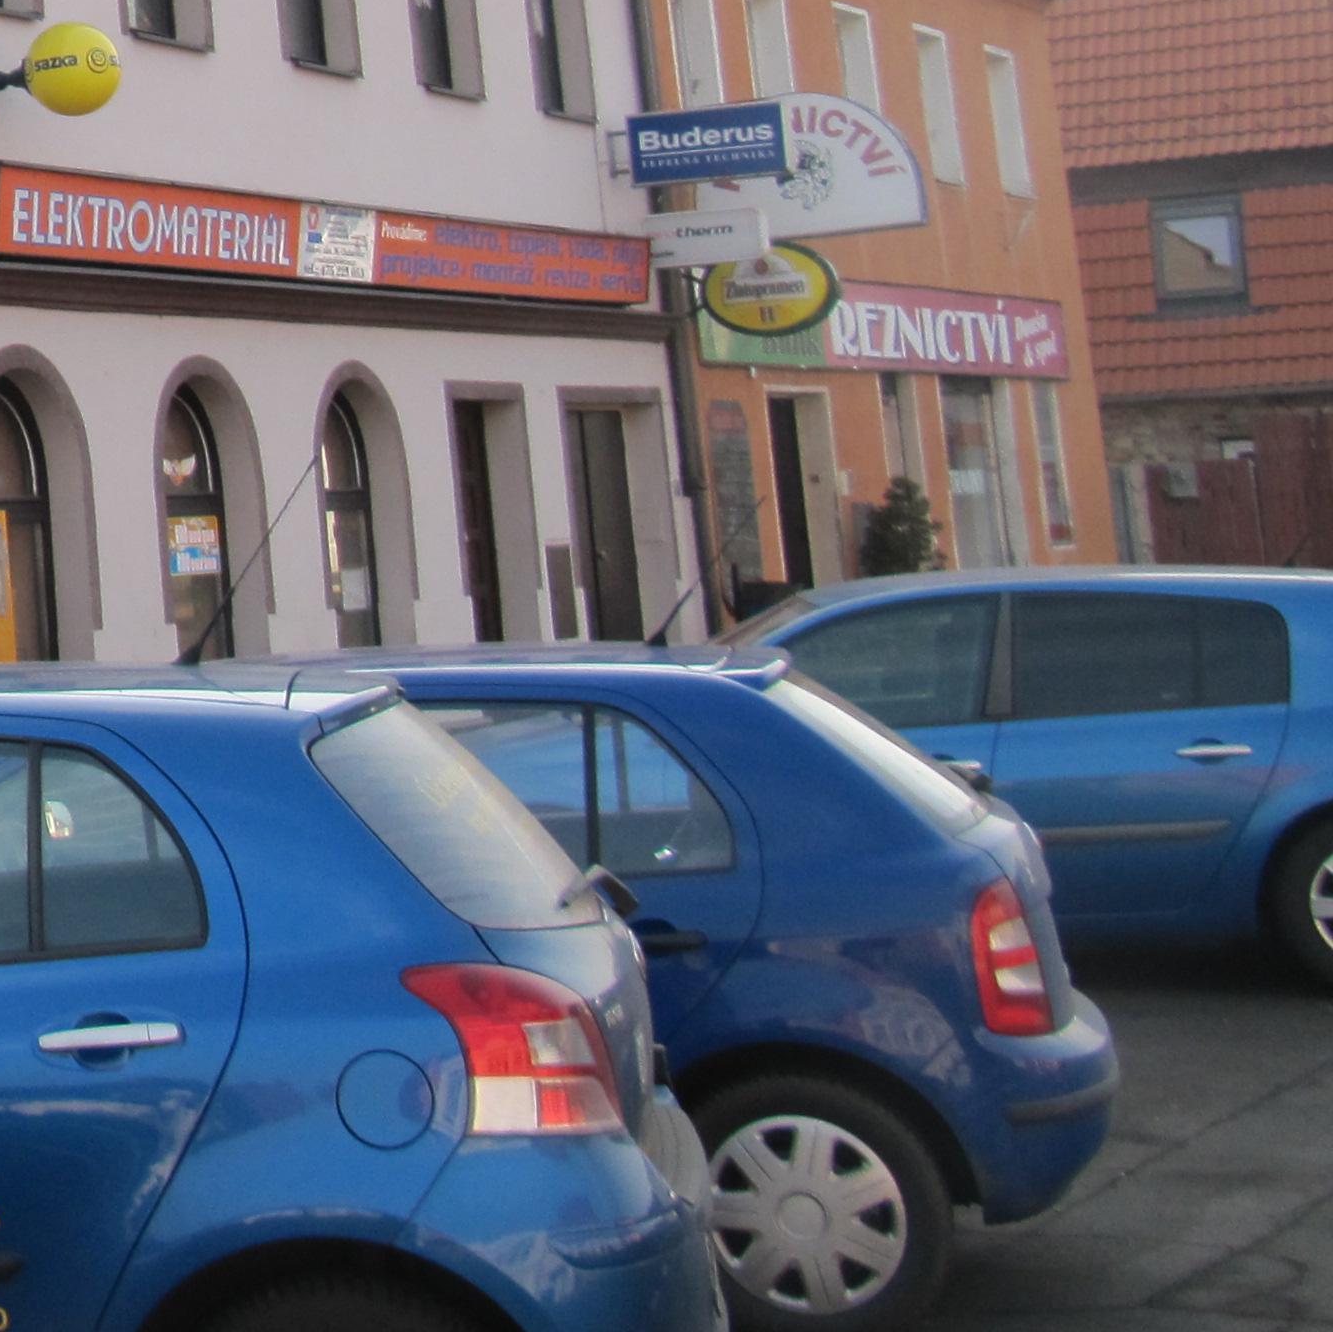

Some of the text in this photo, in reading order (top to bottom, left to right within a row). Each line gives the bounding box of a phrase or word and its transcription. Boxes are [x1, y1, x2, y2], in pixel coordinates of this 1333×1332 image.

[637, 123, 774, 152] Buderus
[706, 149, 776, 163] TECHNIKA
[12, 188, 291, 266] ELEKTROMATERIÁL
